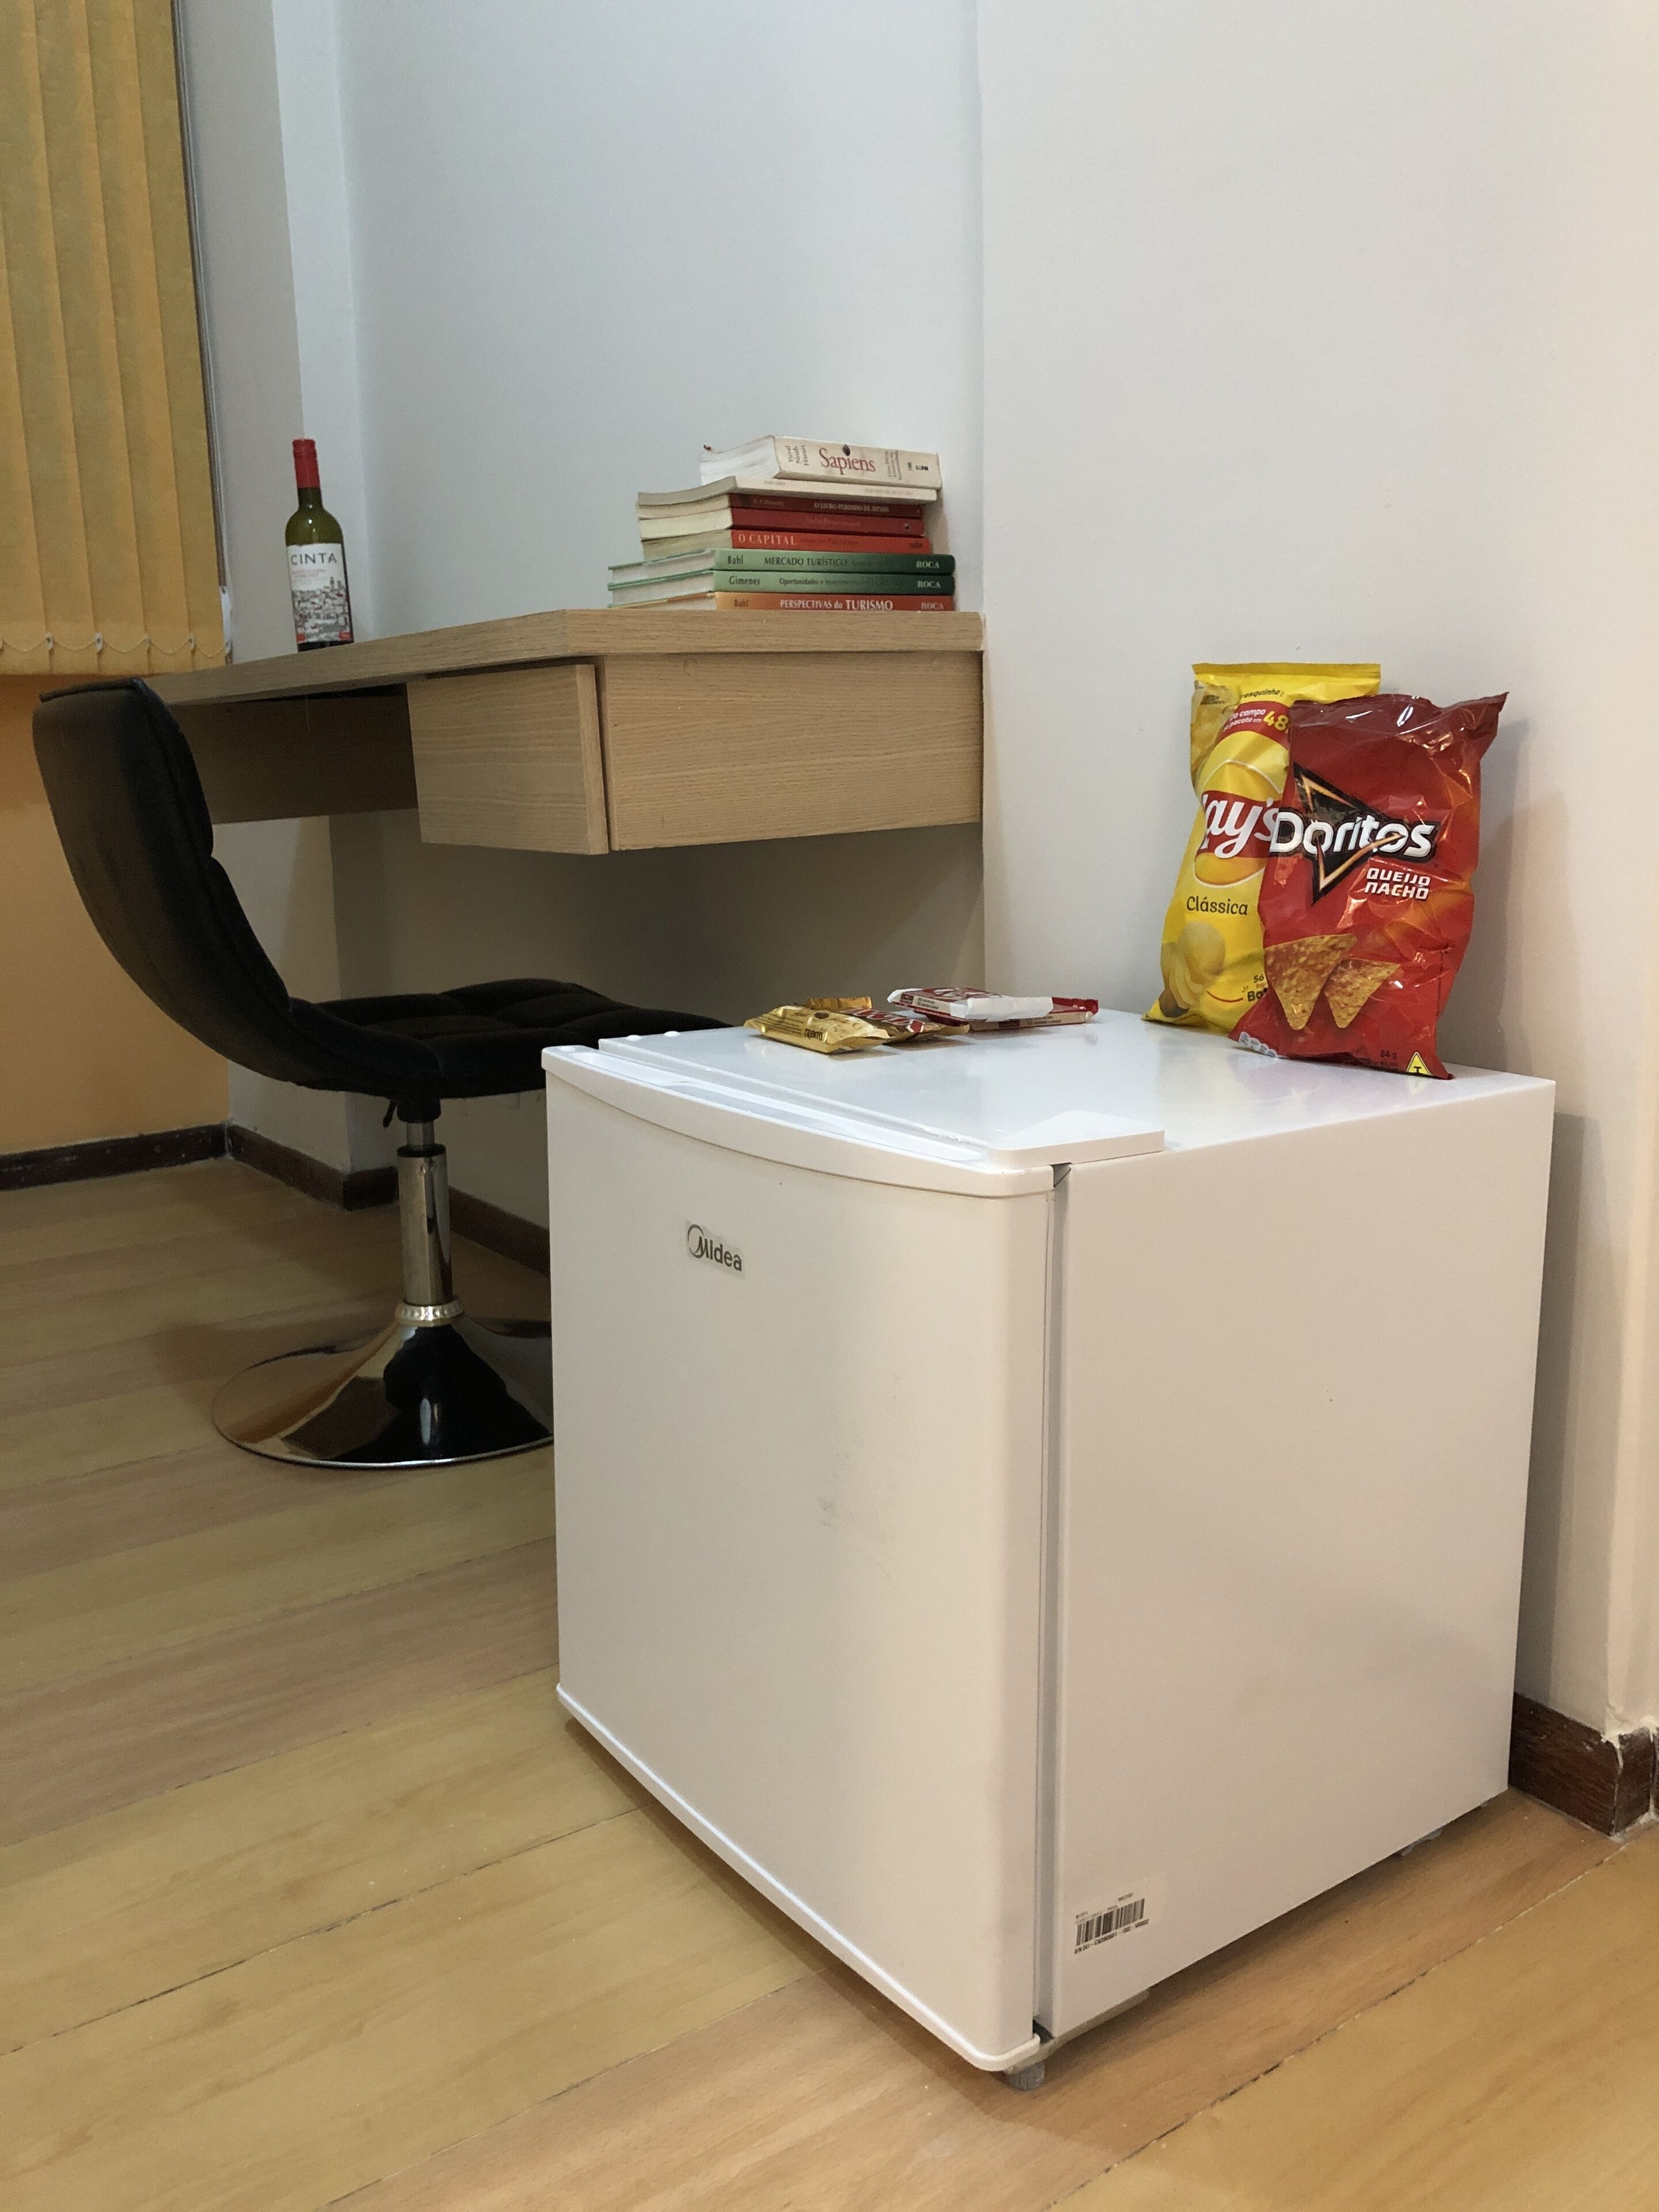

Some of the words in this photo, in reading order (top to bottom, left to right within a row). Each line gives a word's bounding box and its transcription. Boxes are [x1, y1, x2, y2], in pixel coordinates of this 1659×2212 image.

[819, 448, 876, 475] Sapiens
[738, 534, 745, 544] O
[749, 534, 797, 546] CAPITAL
[290, 552, 337, 565] CINTA
[728, 555, 744, 565] Bahl
[764, 556, 804, 566] MERCADO
[916, 560, 940, 569] ROCA
[729, 575, 760, 585] Gimenes
[779, 577, 819, 586] Oportunidades
[917, 580, 941, 588] ROCA
[734, 599, 749, 607] Bahl
[780, 599, 832, 609] PERSPECTIVAS
[844, 599, 893, 611] TURISMO
[921, 601, 944, 610] ROCA
[1239, 709, 1267, 718] campo
[1269, 814, 1435, 858] Doritos
[1366, 867, 1431, 887] QUEIJO
[1364, 881, 1429, 900] NACHO
[1186, 896, 1249, 915] Clássica
[1253, 974, 1264, 983] Só
[1380, 1050, 1389, 1058] 84
[688, 1224, 742, 1272] Midea
